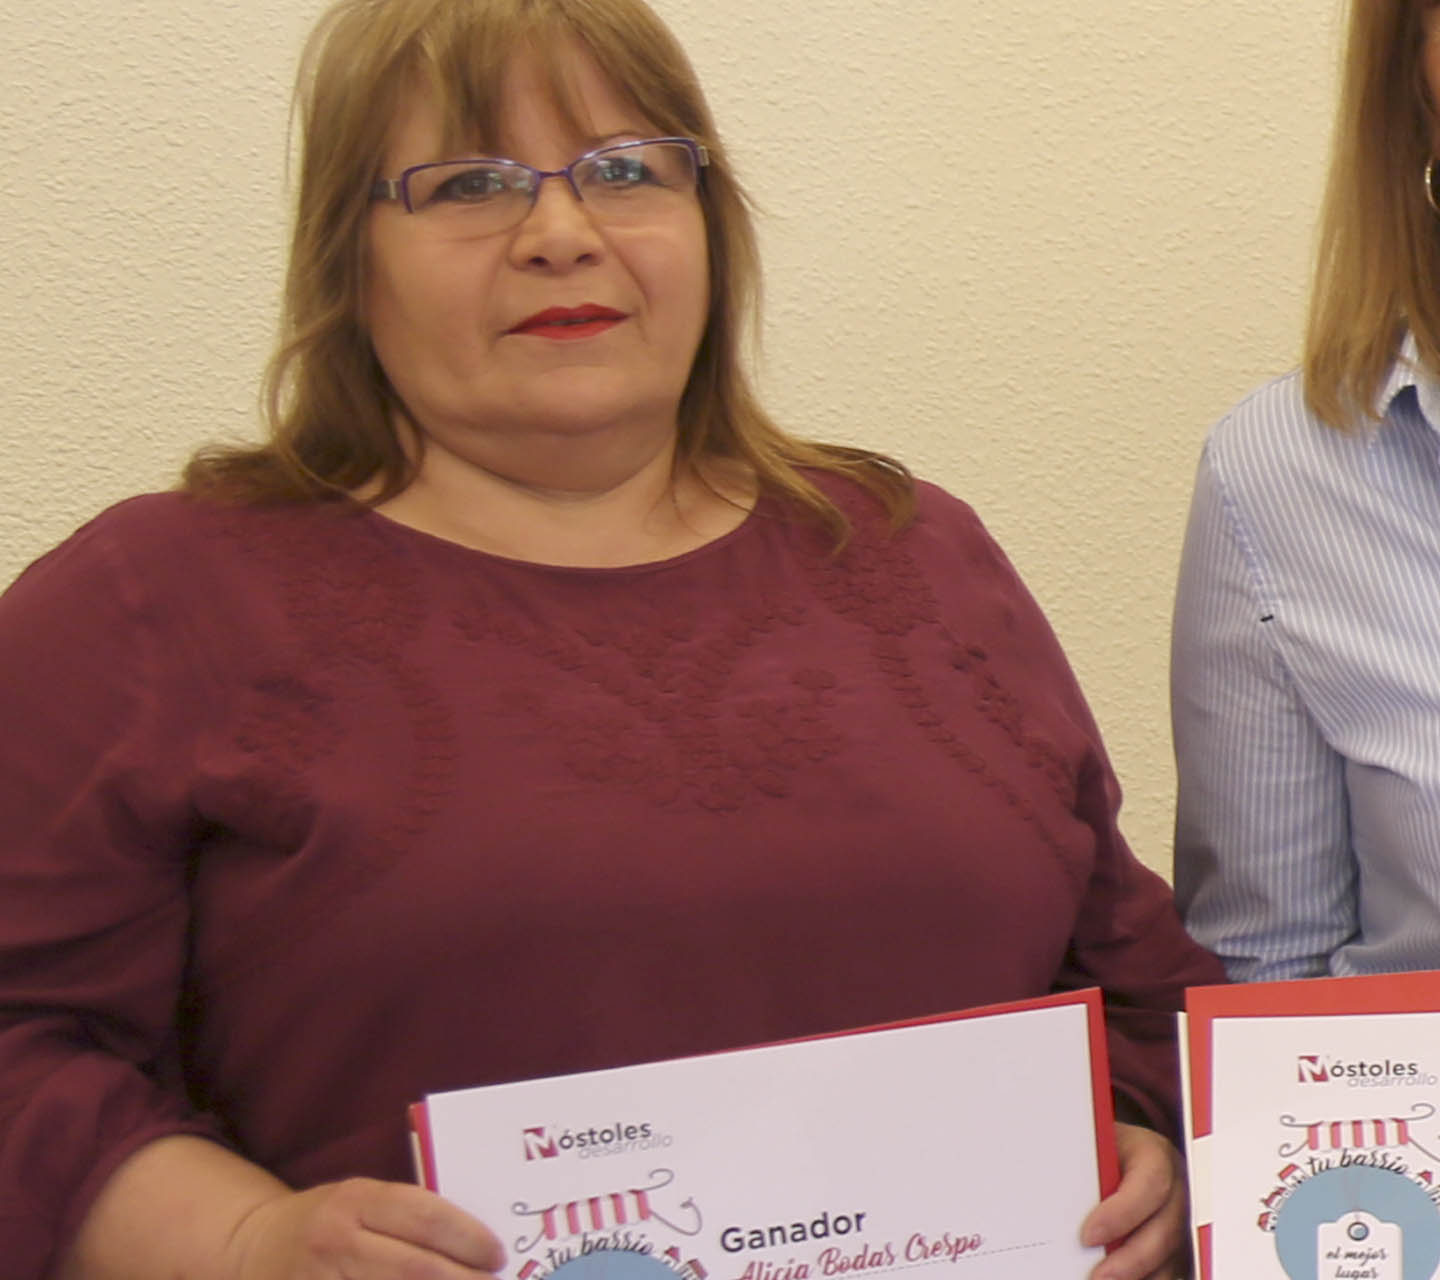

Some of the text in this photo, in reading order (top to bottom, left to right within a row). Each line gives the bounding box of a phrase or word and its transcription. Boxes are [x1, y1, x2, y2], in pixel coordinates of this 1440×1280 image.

[1346, 1073, 1439, 1088] desarrollo
[1306, 1148, 1411, 1176] tu barrio
[719, 1212, 867, 1253] Ganador
[546, 1230, 656, 1270] tu barrio
[818, 1241, 896, 1277] Bodas
[904, 1231, 985, 1264] Crespo
[1326, 1246, 1387, 1267] el mejor
